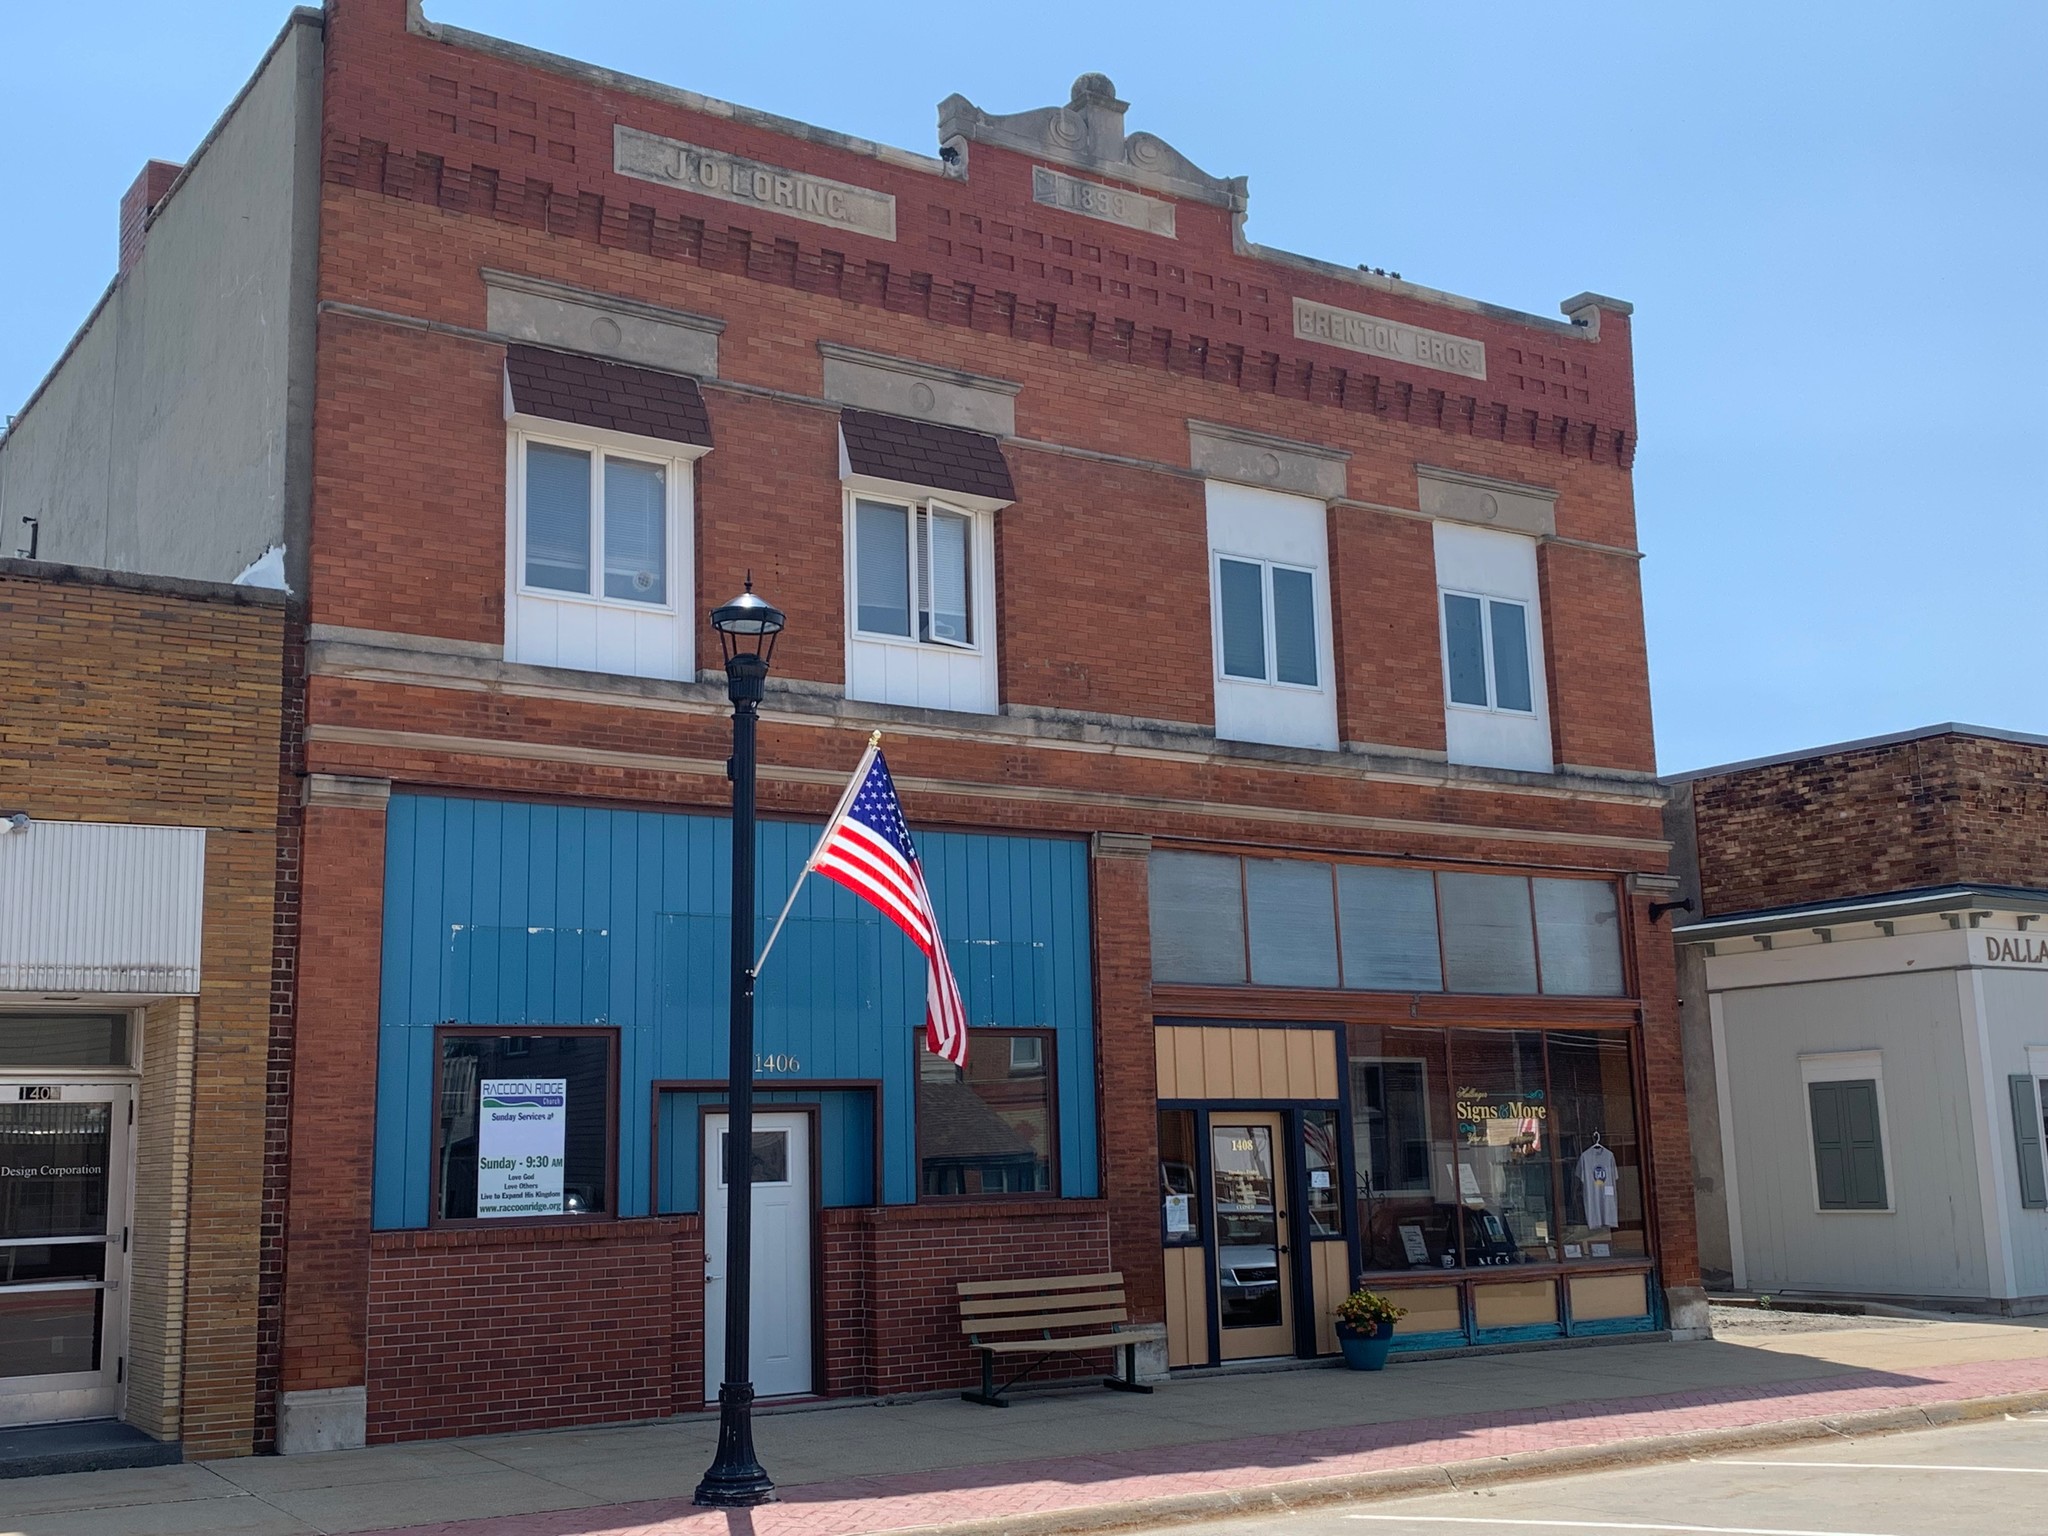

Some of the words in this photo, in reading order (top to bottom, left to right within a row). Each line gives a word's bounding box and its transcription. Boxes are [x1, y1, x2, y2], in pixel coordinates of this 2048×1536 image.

[1299, 306, 1403, 356] BRENTON
[754, 1053, 800, 1073] 1406
[482, 1083, 533, 1096] RACCOON
[535, 1082, 564, 1095] RIDGE
[542, 1097, 561, 1106] Church
[491, 1112, 517, 1123] Sunday
[517, 1111, 546, 1122] Services
[546, 1112, 554, 1121] at
[1456, 1101, 1498, 1123] Signs
[1508, 1101, 1547, 1120] More
[1231, 1139, 1254, 1151] 1408
[480, 1156, 517, 1171] Sunday
[526, 1155, 549, 1168] 9:30
[551, 1158, 563, 1168] AM
[1, 1165, 38, 1179] Design
[40, 1163, 102, 1178] Corporation
[508, 1173, 522, 1181] Love
[502, 1192, 524, 1200] Expand
[535, 1190, 561, 1198] Kingdom
[479, 1202, 562, 1213] www.raccoonridge.org
